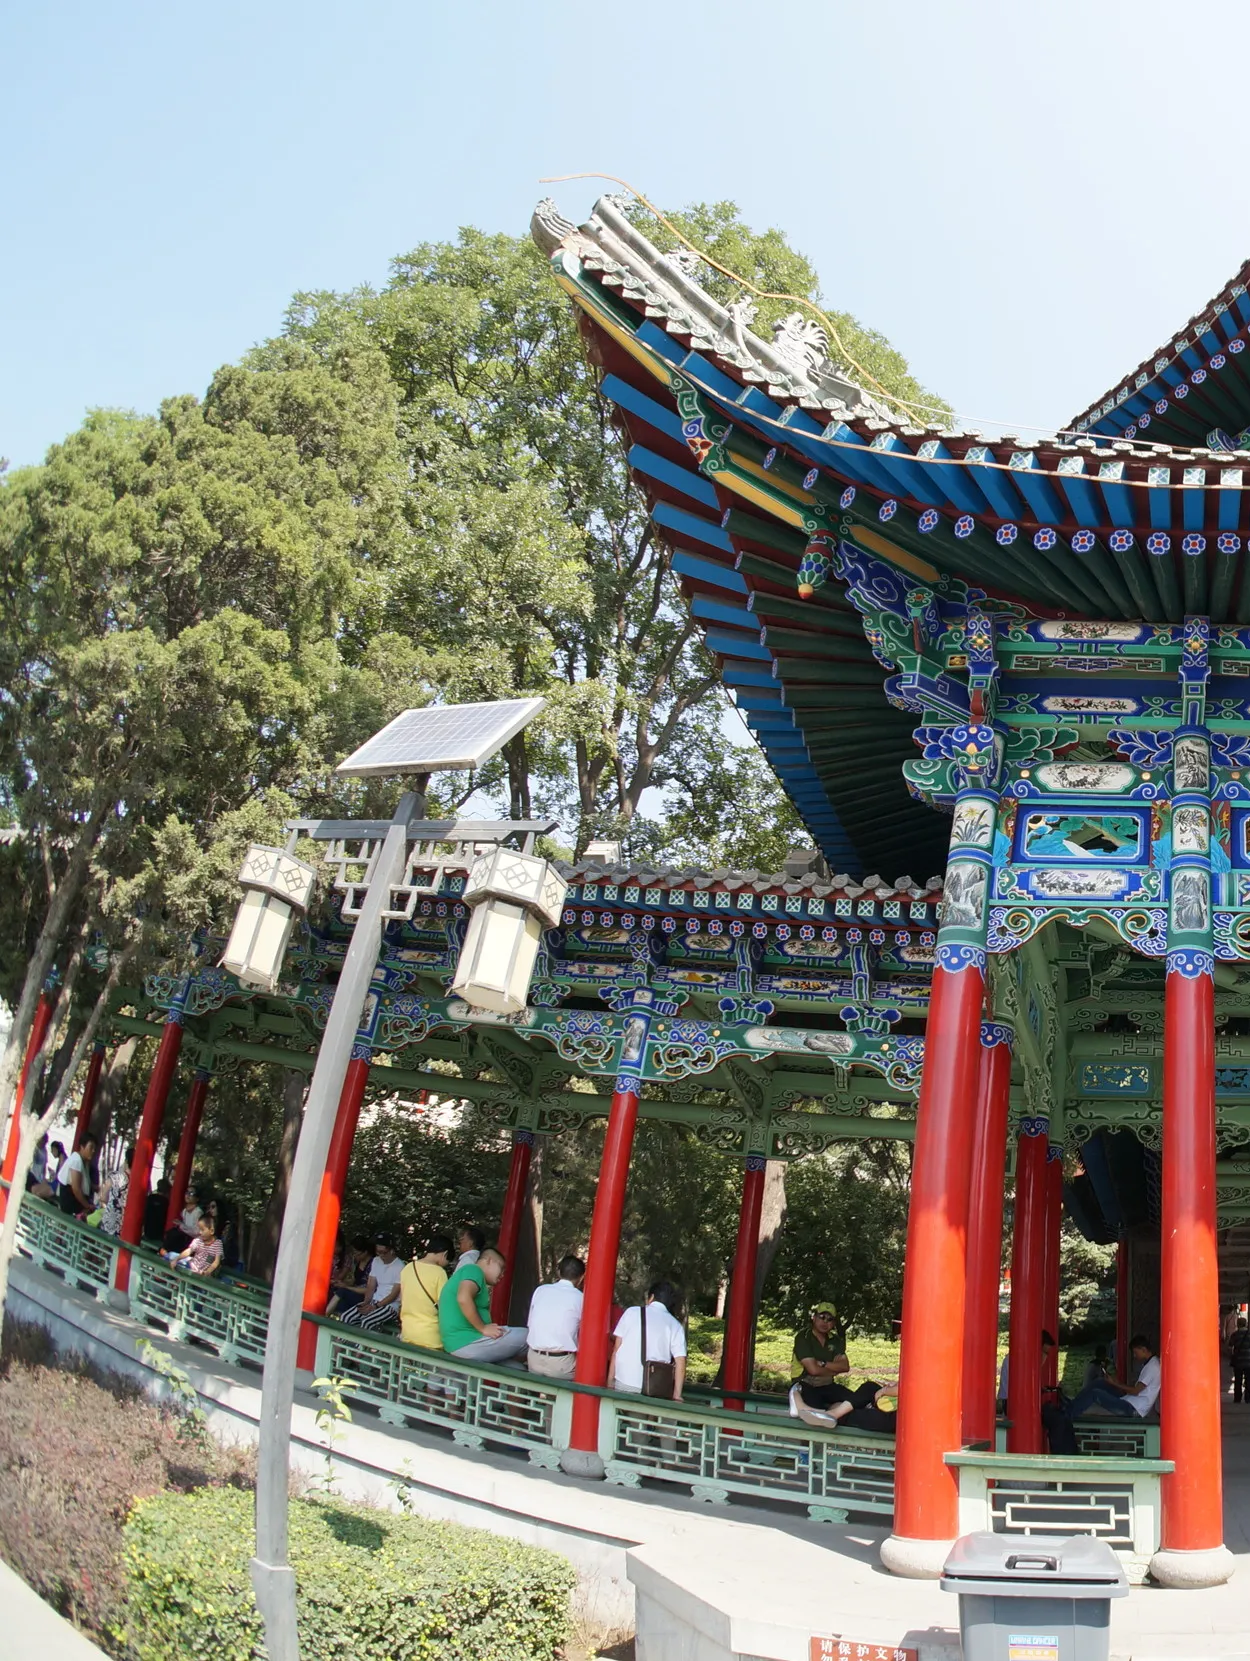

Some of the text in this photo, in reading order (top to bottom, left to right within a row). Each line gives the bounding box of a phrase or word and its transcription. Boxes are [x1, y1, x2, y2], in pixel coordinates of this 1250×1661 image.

[821, 1640, 907, 1661] 请保护文物
